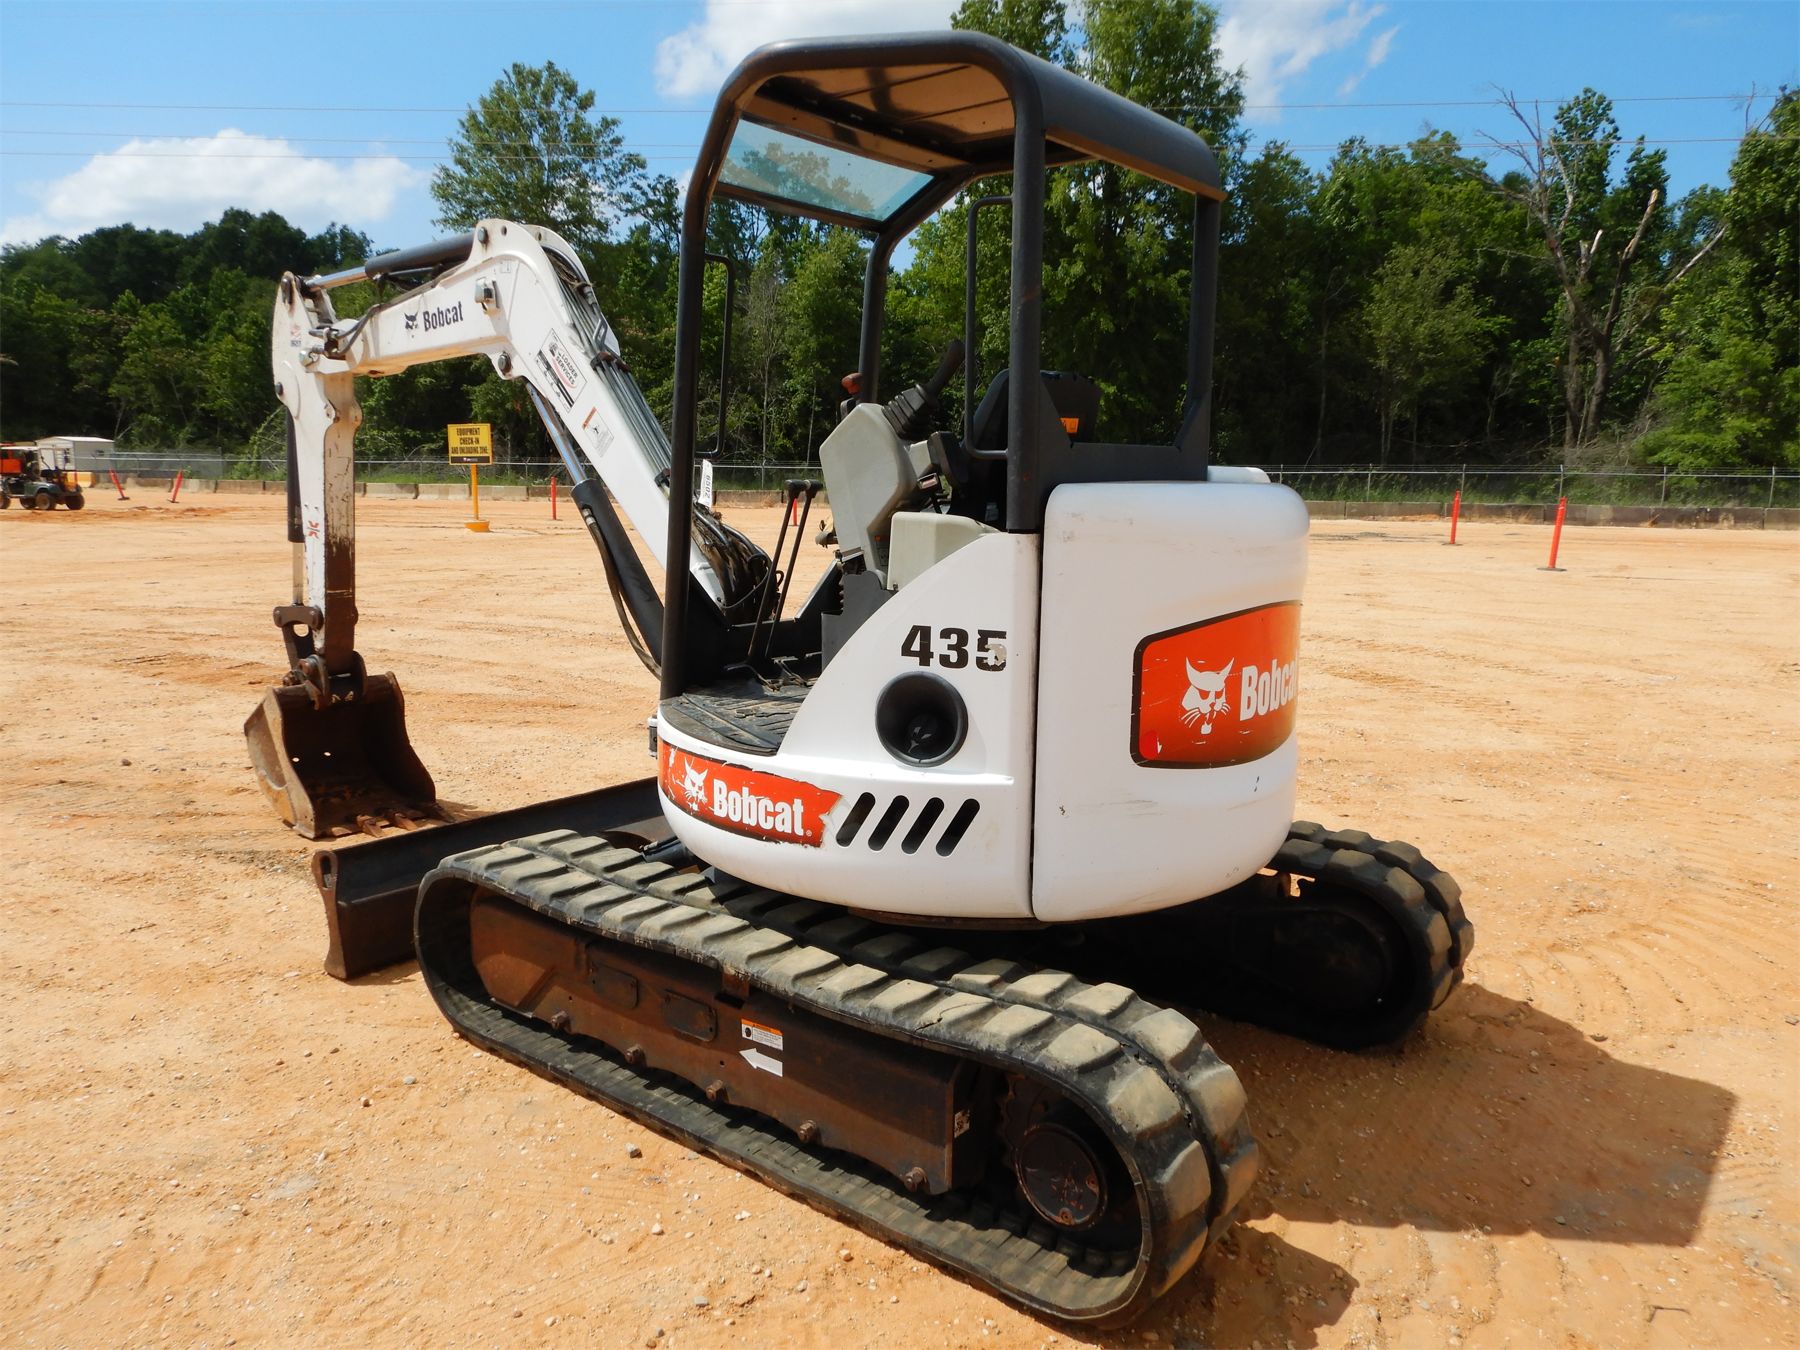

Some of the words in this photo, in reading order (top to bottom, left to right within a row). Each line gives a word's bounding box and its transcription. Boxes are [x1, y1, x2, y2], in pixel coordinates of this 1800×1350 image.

[423, 301, 464, 331] Bobcat
[556, 356, 576, 385] SERVICES
[561, 354, 578, 379] LOADER
[456, 427, 481, 436] EQUIPMENT
[459, 437, 480, 445] CHECK-IN
[901, 625, 1007, 672] 435
[1240, 658, 1298, 721] Bobca
[713, 779, 804, 836] Bobcat
